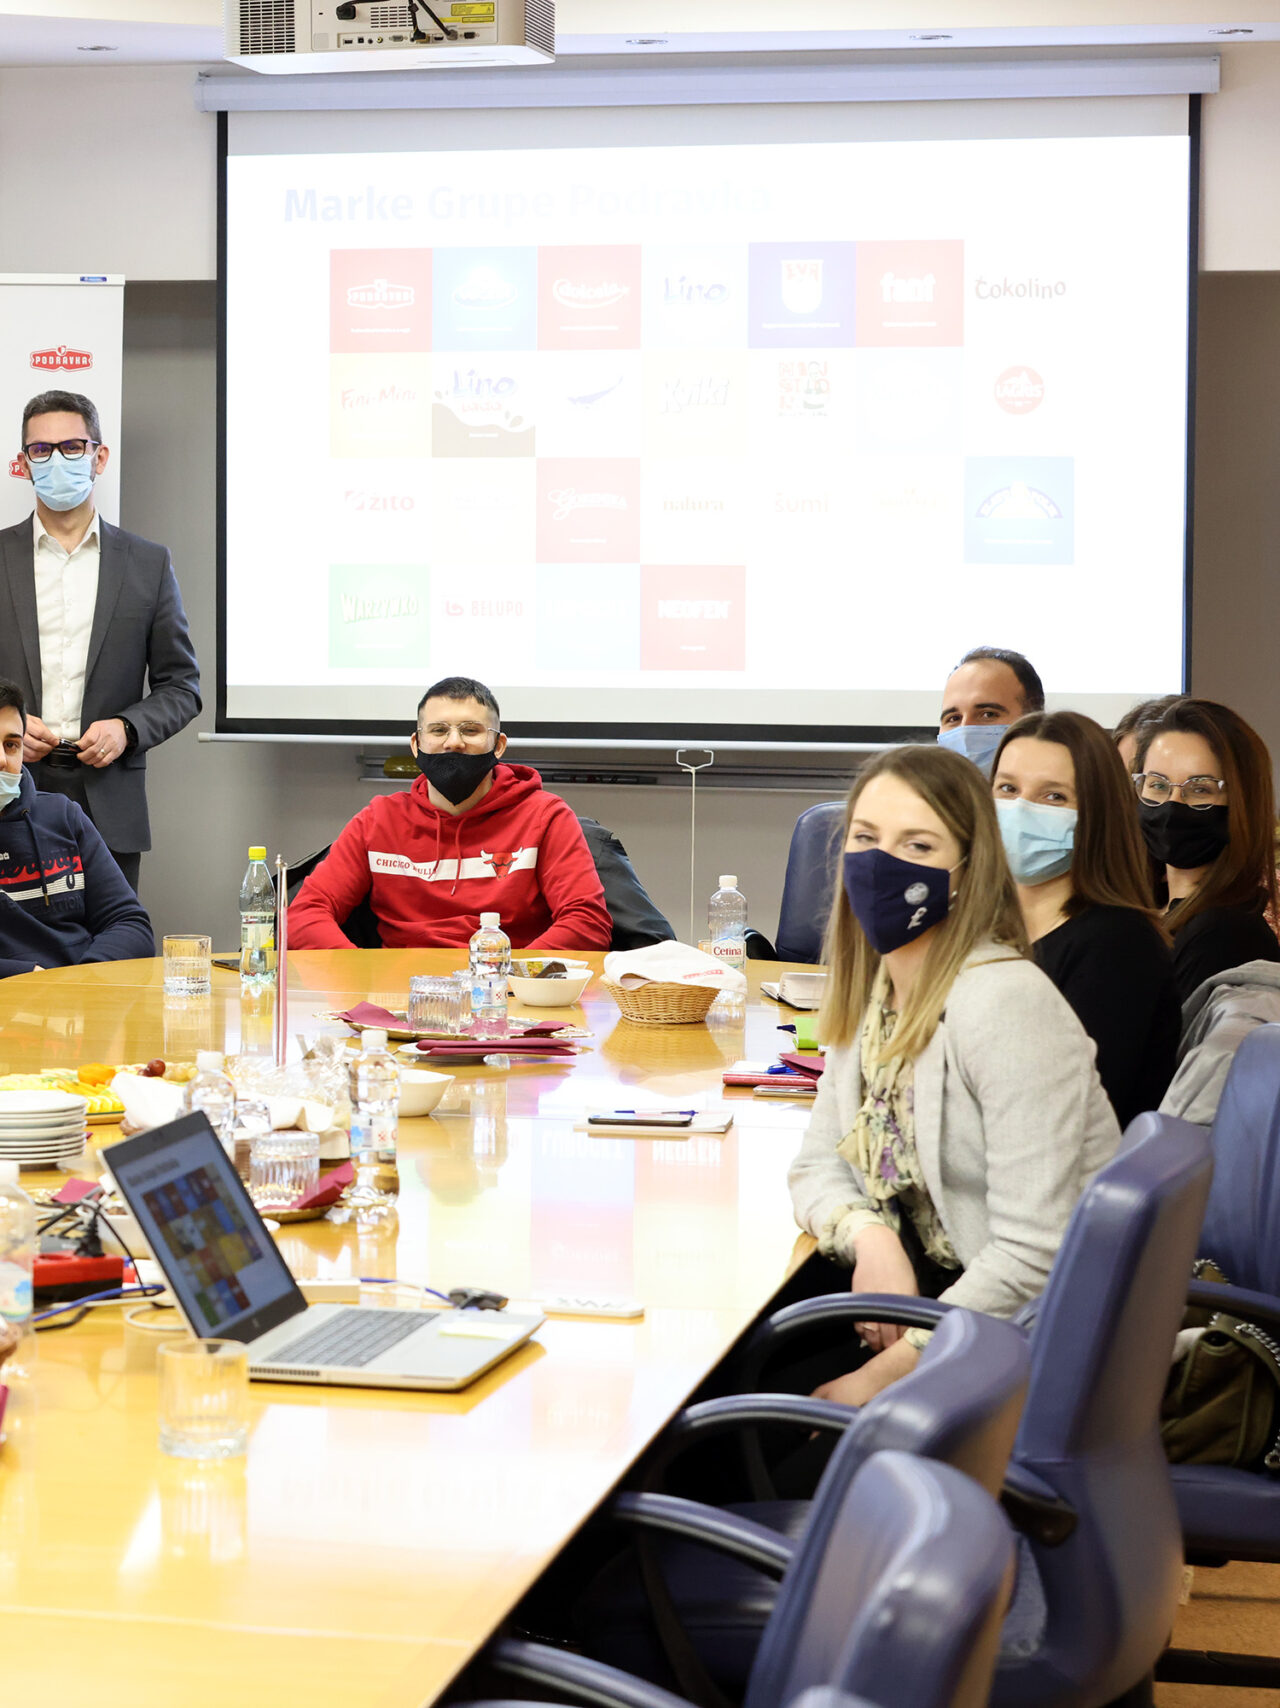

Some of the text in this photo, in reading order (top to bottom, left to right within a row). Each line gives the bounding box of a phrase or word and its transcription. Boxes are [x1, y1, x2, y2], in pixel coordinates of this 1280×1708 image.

[284, 178, 772, 228] Marke Grupe Podravka
[974, 273, 1067, 301] Čokolino
[35, 355, 88, 366] PODRAVKA
[471, 600, 524, 617] BELUPO
[713, 946, 742, 956] Cetina
